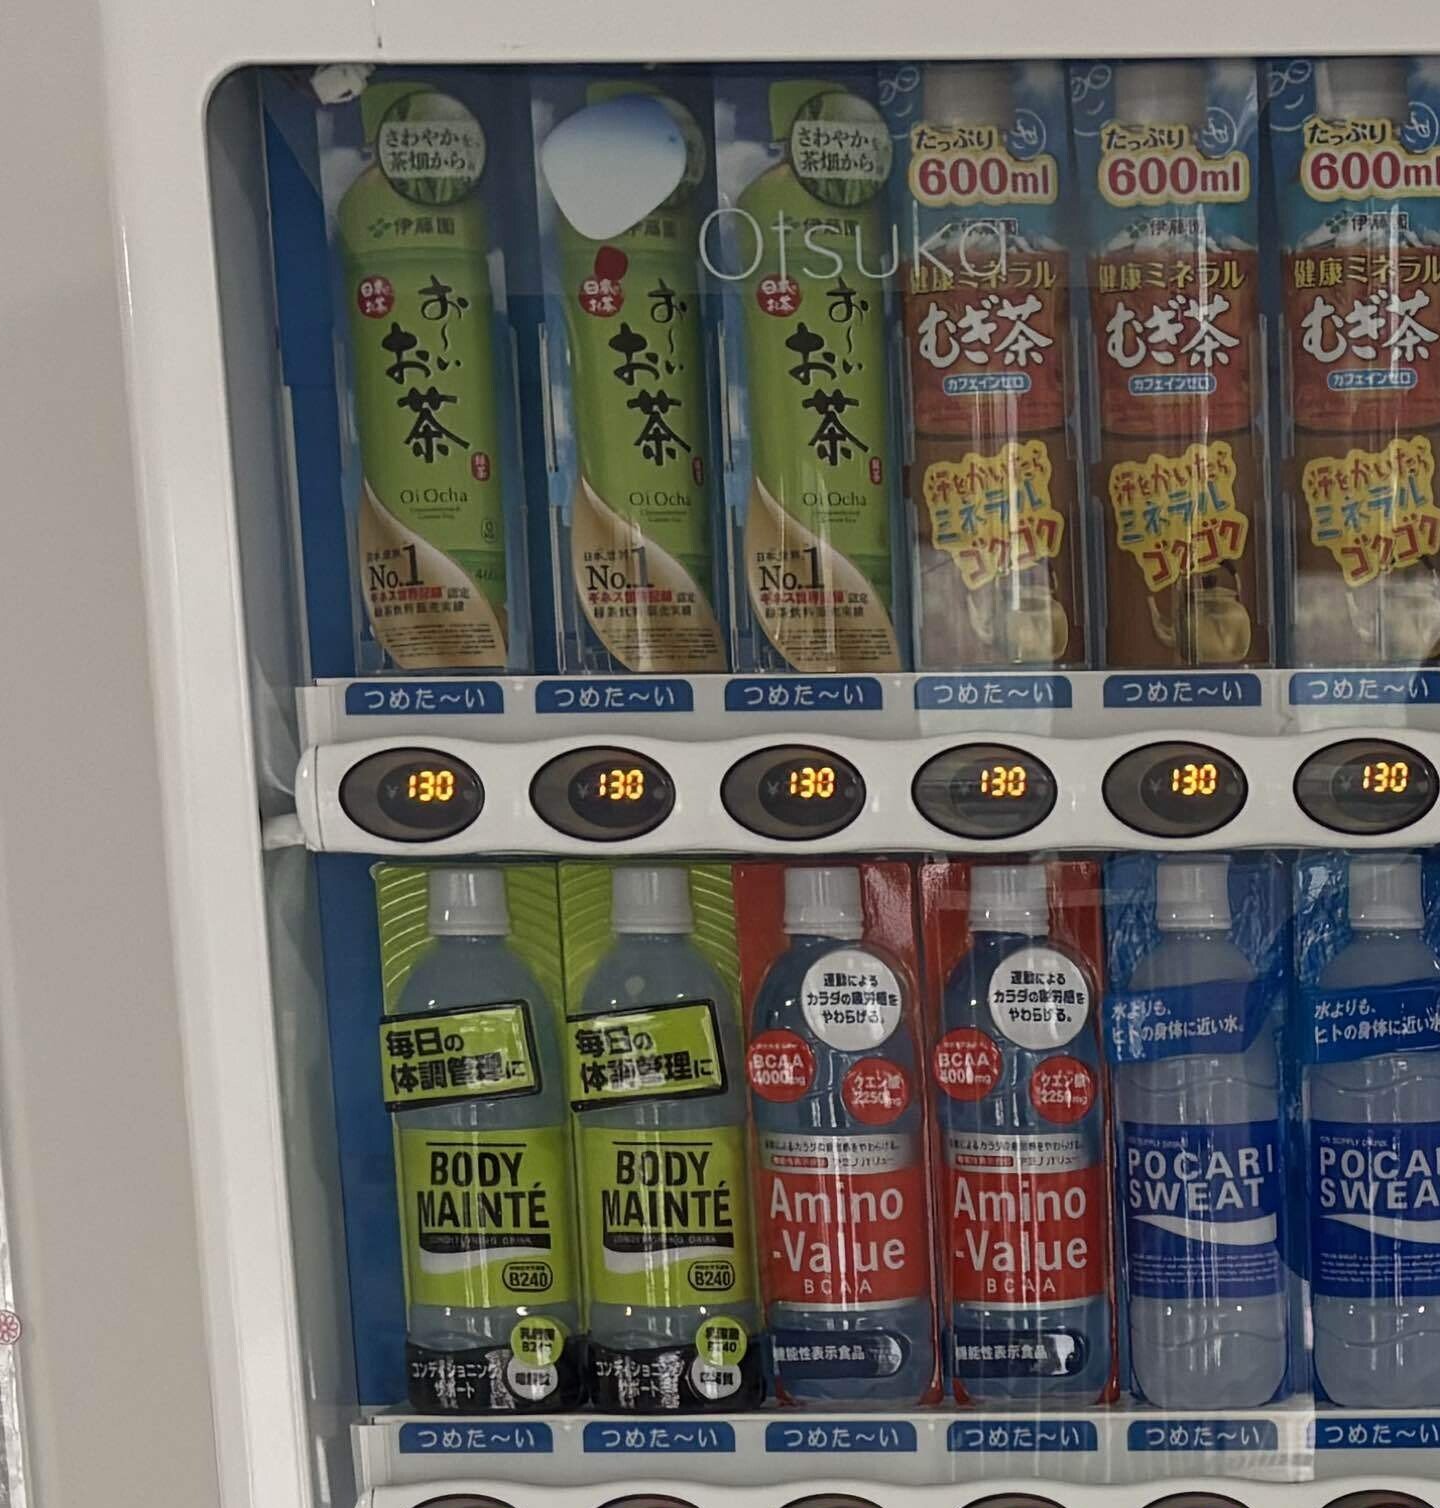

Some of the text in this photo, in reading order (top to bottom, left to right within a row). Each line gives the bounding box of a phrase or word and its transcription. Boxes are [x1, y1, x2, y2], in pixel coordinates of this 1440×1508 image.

[917, 157, 1051, 196] 600ml
[1107, 157, 1241, 195] 600ml
[918, 294, 1053, 368] むぎ茶
[1106, 294, 1240, 368] むぎ茶
[1302, 289, 1438, 363] むぎ茶
[409, 771, 453, 801] 130
[600, 770, 643, 799] 130
[791, 768, 834, 797] 130
[982, 767, 1025, 796] 130
[1173, 764, 1216, 795] 130
[1364, 763, 1407, 792] 130
[386, 1027, 465, 1058] 毎日の
[430, 1151, 523, 1187] BODY
[615, 1150, 710, 1187] BODY
[769, 1177, 903, 1223] Amino
[954, 1177, 1087, 1222] Amino
